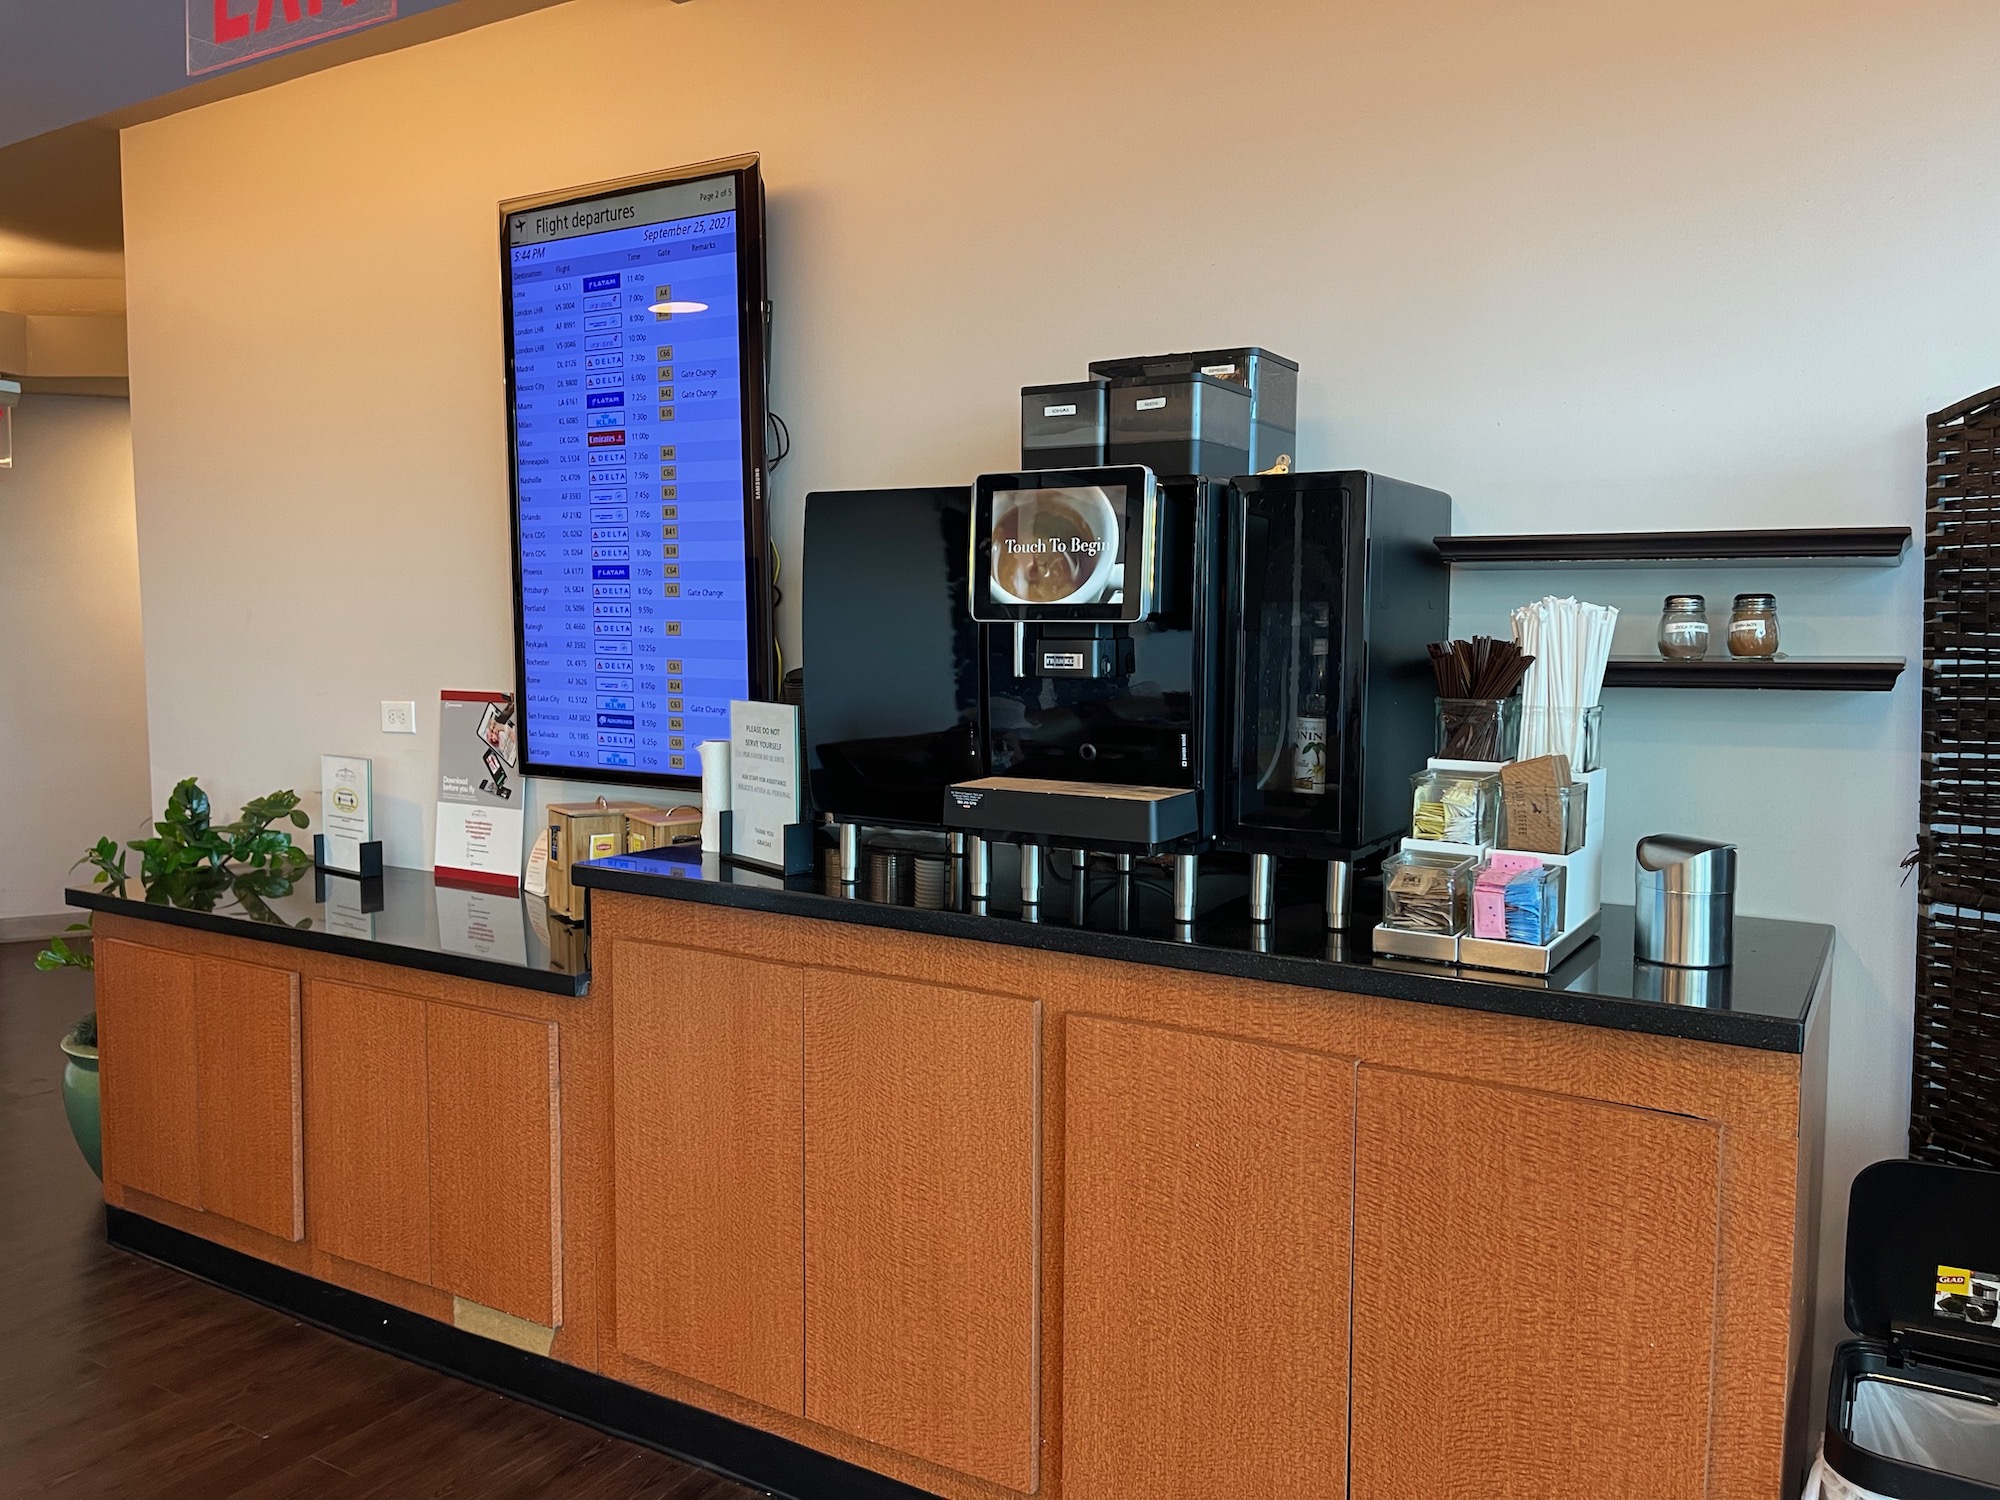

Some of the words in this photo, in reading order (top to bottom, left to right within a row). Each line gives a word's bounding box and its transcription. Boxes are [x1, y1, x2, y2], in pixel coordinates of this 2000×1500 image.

[699, 192, 714, 202] Page
[714, 190, 719, 199] 2
[719, 188, 727, 198] of
[727, 187, 732, 197] 5
[536, 214, 569, 236] Flight
[571, 205, 635, 229] departures
[643, 223, 692, 243] September
[692, 219, 706, 234] 25,
[708, 215, 731, 231] 2021
[513, 249, 531, 262] 5:44
[531, 246, 546, 259] PM
[513, 270, 543, 280] Destination
[555, 264, 570, 275] Flight
[627, 253, 641, 261] Time
[657, 248, 671, 257] Gate
[691, 241, 716, 251] Remarks
[553, 283, 562, 292] LA
[561, 282, 571, 291] 531
[592, 278, 616, 289] LATAM
[626, 273, 645, 282] 11:40p
[514, 308, 533, 317] London
[554, 303, 562, 311] VS
[562, 301, 575, 310] 0004
[628, 293, 644, 302] 7:00p
[659, 289, 667, 297] A4
[514, 327, 533, 336] London
[555, 321, 562, 330] AF
[515, 346, 534, 355] London
[555, 341, 563, 349] VS
[628, 333, 647, 342] 10:00p
[515, 364, 534, 373] Madrid
[556, 360, 564, 369] DL
[594, 356, 622, 366] DELTA
[630, 353, 646, 362] 7:30p
[659, 349, 670, 357] C66
[534, 382, 545, 392] City
[557, 379, 565, 388] DL
[595, 376, 622, 386] DELTA
[630, 372, 646, 382] 6:00p
[661, 369, 670, 377] A5
[680, 370, 695, 378] Gate
[695, 368, 717, 378] Change
[557, 398, 565, 407] LA
[596, 395, 620, 405] LATAM
[631, 392, 647, 402] 7:25p
[661, 389, 671, 397] B42
[681, 390, 695, 399] Gate
[695, 389, 718, 399] Change
[558, 417, 566, 425] KL
[595, 416, 617, 425] KLM
[631, 412, 648, 421] 7:30p
[558, 436, 566, 444] EK
[631, 432, 650, 441] 11:00p
[559, 455, 567, 463] DL
[597, 453, 624, 463] DELTA
[633, 451, 649, 460] 7:35p
[560, 474, 568, 482] DL
[598, 473, 625, 482] DELTA
[633, 470, 649, 480] 7:59p
[560, 492, 568, 500] AF
[634, 490, 650, 500] 7:45p
[520, 513, 542, 521] Orlando
[561, 511, 569, 519] AF
[635, 509, 651, 519] 7:05p
[562, 530, 570, 538] DL
[599, 530, 627, 539] DELTA
[635, 529, 651, 538] 6:30p
[665, 527, 675, 535] B41
[562, 548, 570, 556] DL
[600, 549, 627, 558] DELTA
[636, 548, 652, 558] 9:30p
[1005, 538, 1046, 553] Touch
[1049, 538, 1066, 552] To
[1071, 537, 1109, 556] Begin
[563, 567, 571, 575] LA
[601, 568, 625, 577] LATAM
[637, 567, 653, 577] 7:59p
[666, 566, 677, 574] C64
[523, 586, 550, 596] Pittsburgh
[564, 585, 571, 593] DL
[601, 588, 628, 596] DELTA
[666, 585, 678, 594] C63
[687, 588, 701, 597] Gate
[701, 588, 724, 599] Change
[524, 604, 546, 612] Portland
[564, 603, 572, 612] DL
[602, 607, 629, 615] DELTA
[564, 622, 572, 630] DL
[602, 626, 629, 634] DELTA
[638, 625, 654, 634] 7:45p
[668, 624, 678, 632] B47
[565, 640, 573, 648] AF
[637, 643, 656, 653] 10:25p
[525, 657, 550, 666] Rochester
[566, 658, 574, 667] DL
[603, 663, 631, 671] DELTA
[639, 662, 656, 672] 9:10p
[668, 662, 680, 671] C61
[526, 675, 541, 684] Rome
[567, 677, 574, 685] AF
[669, 682, 680, 690] B24
[537, 694, 549, 702] Lake
[549, 694, 560, 704] City
[567, 695, 574, 703] KL
[603, 700, 625, 709] KLM
[640, 700, 657, 710] 6:15p
[670, 700, 681, 709] C63
[690, 704, 704, 713] Gate
[704, 705, 727, 716] Change
[527, 711, 537, 719] San
[568, 713, 578, 721] AM
[746, 725, 761, 733] PLEASE
[528, 729, 538, 737] San
[568, 731, 576, 740] DL
[606, 736, 633, 746] DELTA
[641, 737, 658, 747] 6:25p
[746, 739, 759, 748] SERVE
[528, 747, 551, 758] Santiago
[605, 755, 627, 765] KLM
[642, 756, 658, 766] 6:50p
[443, 776, 468, 785] Download
